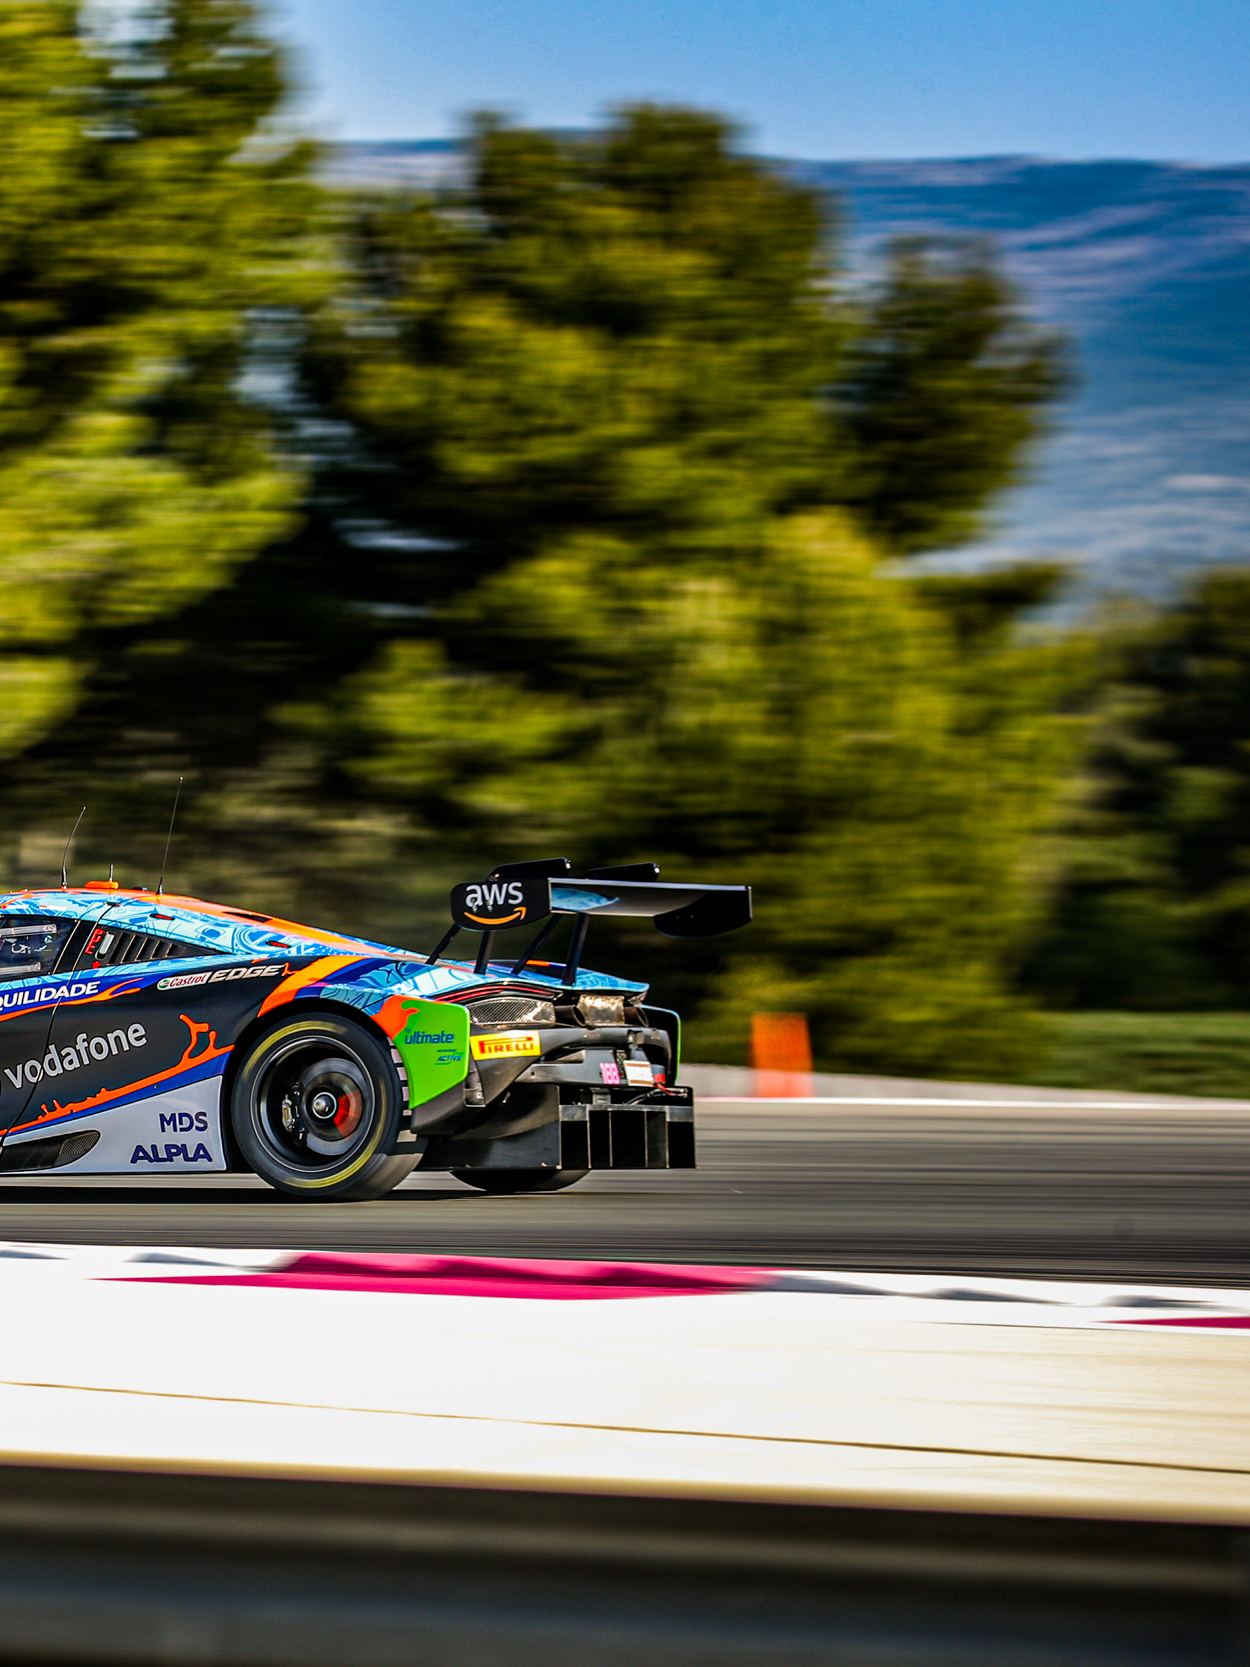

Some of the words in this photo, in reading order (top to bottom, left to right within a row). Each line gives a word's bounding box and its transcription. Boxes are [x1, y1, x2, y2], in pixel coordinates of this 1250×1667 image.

[465, 882, 524, 908] aws
[169, 974, 207, 988] Castrol
[208, 964, 286, 984] EDGE
[404, 1031, 455, 1045] ultimate
[478, 1036, 534, 1054] PIRELLI
[3, 1022, 148, 1089] vodafone
[159, 1111, 209, 1133] MDS
[130, 1143, 213, 1164] ALPLA
